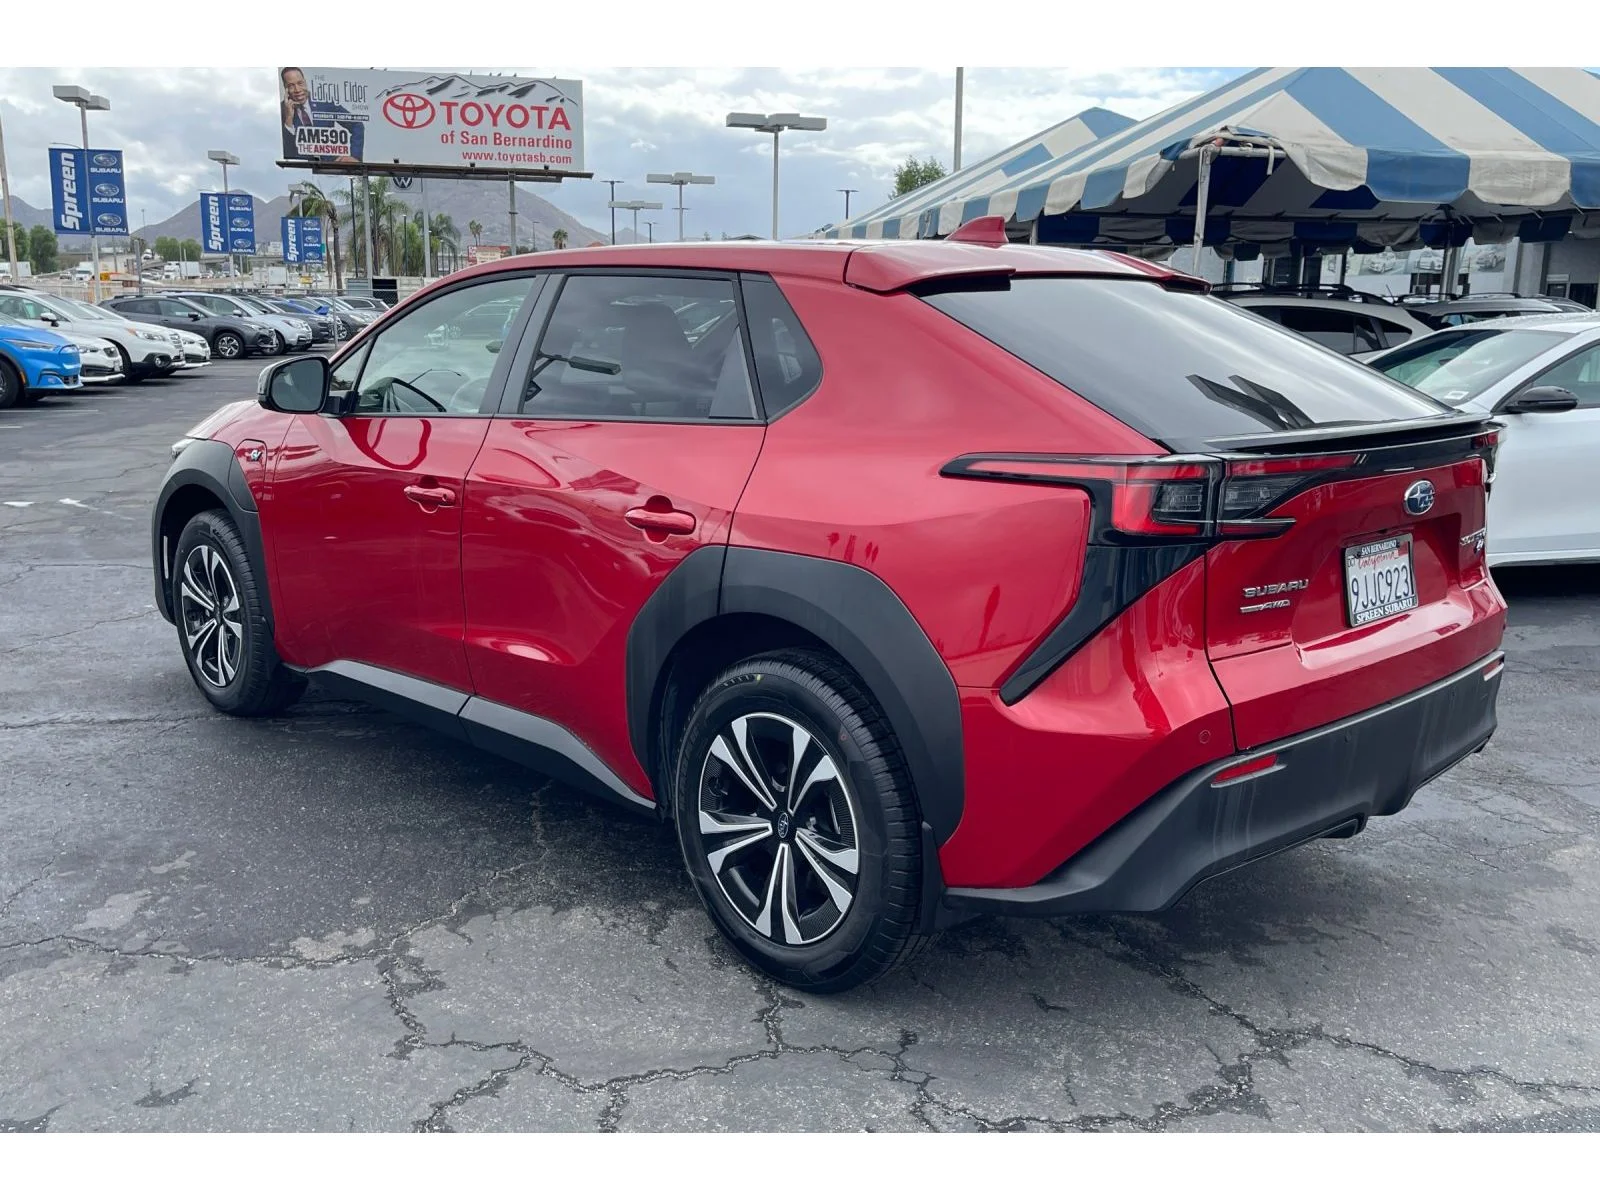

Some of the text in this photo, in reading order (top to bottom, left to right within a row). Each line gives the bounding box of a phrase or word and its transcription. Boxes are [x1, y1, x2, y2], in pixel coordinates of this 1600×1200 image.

[311, 80, 368, 104] Larry Elder
[440, 101, 571, 131] TOYOTA
[297, 128, 348, 145] AM590
[441, 131, 572, 149] of San Bernardino
[299, 144, 349, 154] THE ANSWER
[462, 151, 572, 164] www.toyotasb.com
[61, 152, 83, 231] Spreen
[209, 196, 224, 251] Spreen
[287, 219, 299, 262] Spreen
[1243, 579, 1309, 597] SUBARU
[1351, 565, 1409, 613] 9JJC923
[1356, 598, 1412, 622] SPREEN SUBARU
